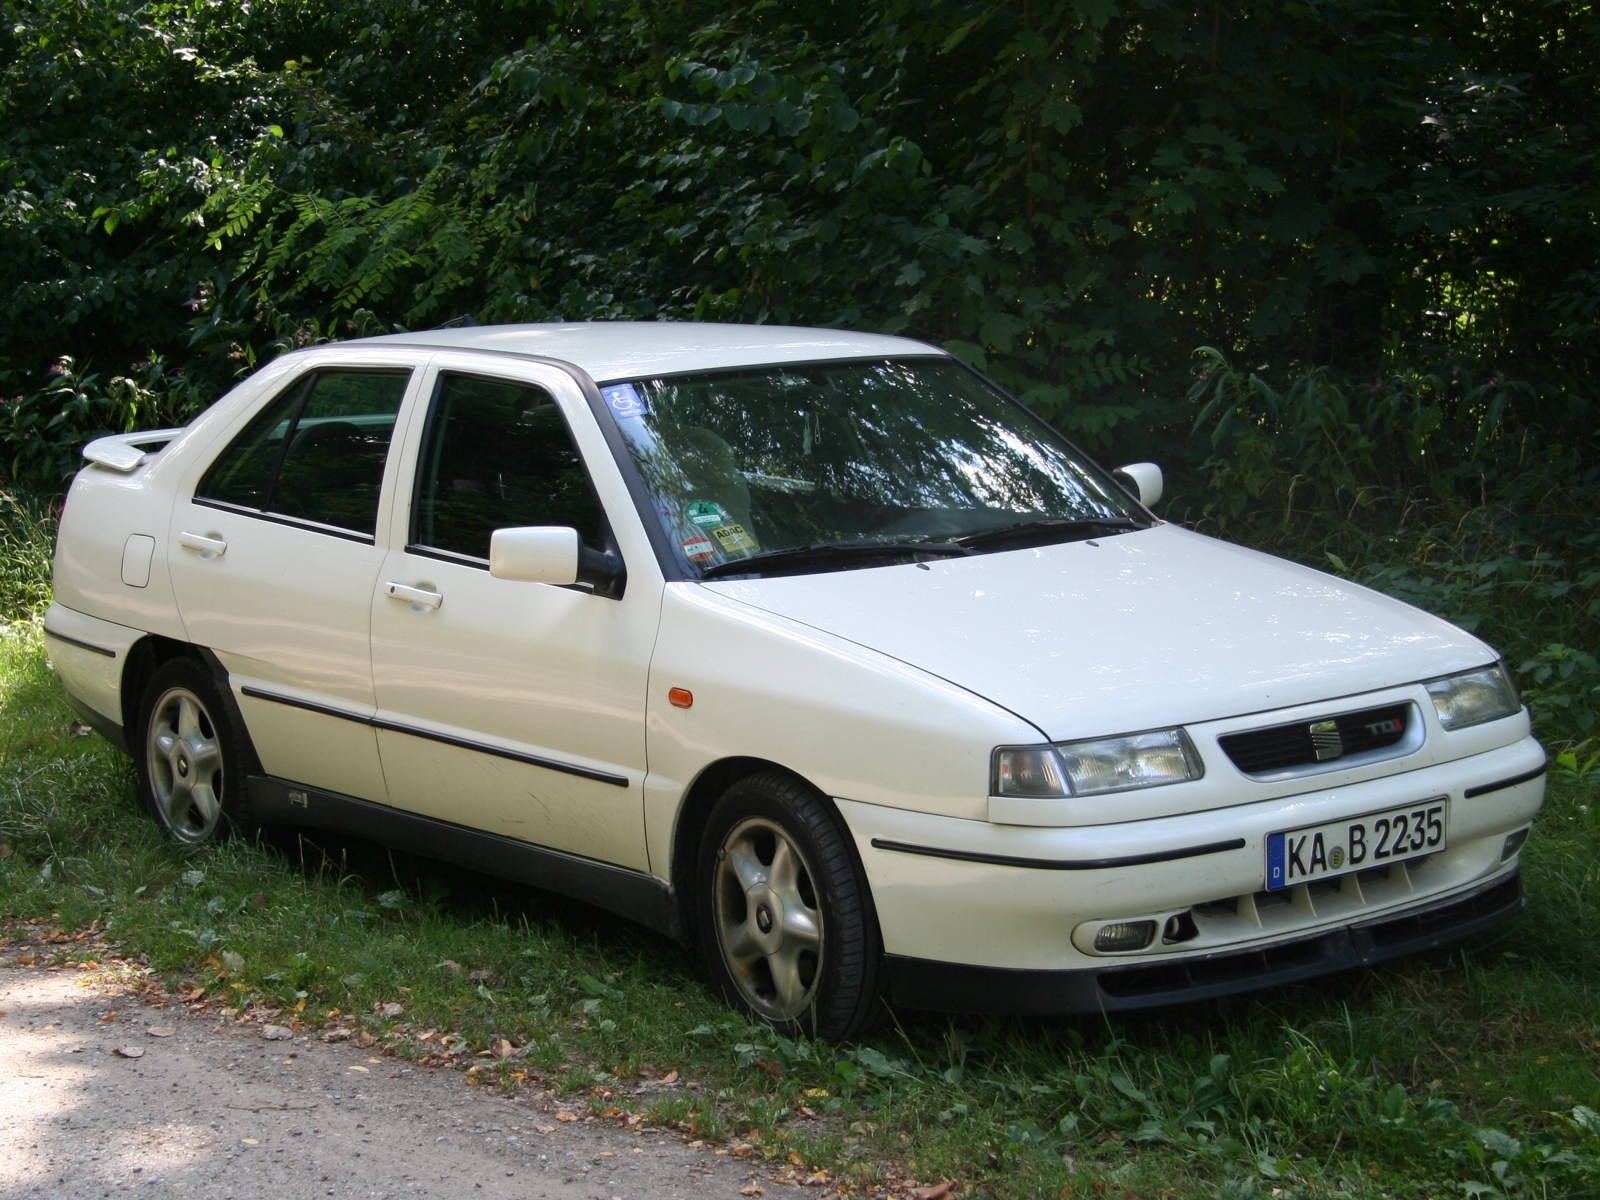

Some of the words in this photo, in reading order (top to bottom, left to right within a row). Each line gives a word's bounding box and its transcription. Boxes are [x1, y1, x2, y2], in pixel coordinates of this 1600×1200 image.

[698, 503, 709, 514] 4
[716, 526, 743, 538] ADAC
[1288, 831, 1327, 878] KA
[1349, 823, 1367, 865] B
[1374, 806, 1442, 859] 2235
[1273, 867, 1280, 879] D
